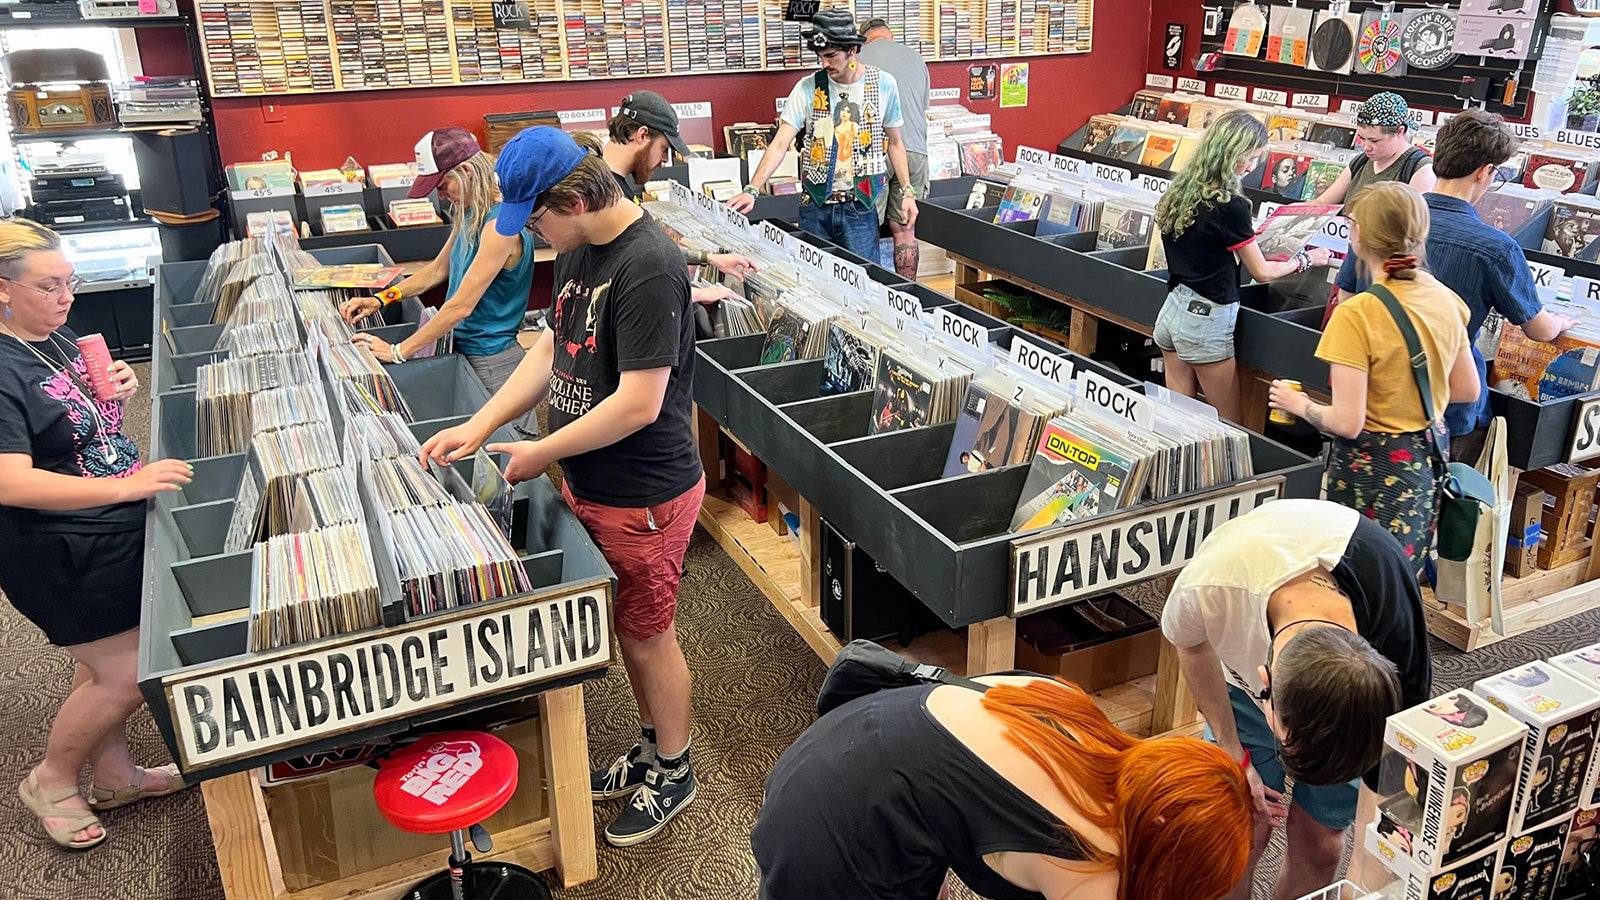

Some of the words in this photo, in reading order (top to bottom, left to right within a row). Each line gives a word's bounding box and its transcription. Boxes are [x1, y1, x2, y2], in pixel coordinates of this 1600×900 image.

[495, 4, 523, 18] ROCK
[790, 3, 816, 14] ROCK
[1404, 13, 1434, 38] ROCKIN'
[1435, 15, 1456, 37] RUBY'S
[1404, 48, 1451, 66] RECORDS
[1180, 80, 1200, 90] JAZZ
[1219, 86, 1240, 96] JAZZ
[1257, 91, 1279, 101] JAZZ
[1297, 95, 1320, 105] JAZZ
[1409, 111, 1423, 122] &B
[1512, 125, 1539, 138] UES
[1557, 131, 1600, 149] BLUES
[1020, 149, 1043, 165] ROCK
[1054, 157, 1079, 173] ROCK
[1338, 154, 1344, 162] G
[1096, 167, 1124, 183] ROCK
[253, 189, 272, 197] 45'S
[324, 185, 343, 193] 45'S
[672, 182, 687, 199] ROCK
[1143, 177, 1170, 193] ROC
[697, 193, 714, 212] ROCK
[1081, 190, 1085, 198] E
[727, 208, 745, 231] ROCK
[764, 225, 785, 248] ROCK
[1322, 222, 1348, 239] OC
[799, 244, 823, 270] ROCK
[834, 263, 860, 290] ROCK
[843, 296, 848, 307] U
[888, 291, 919, 320] ROCK
[861, 318, 867, 330] V
[896, 318, 904, 330] W
[942, 315, 979, 349] ROCK
[938, 357, 944, 369] X
[1018, 345, 1063, 382] ROCK
[550, 371, 593, 402] ROLINE
[1014, 386, 1024, 401] Z
[1551, 384, 1581, 395] JACKSO
[549, 388, 592, 416] LACHEK
[1086, 379, 1137, 422] ROCK
[1577, 405, 1600, 451] S
[184, 629, 454, 755] BAINBRIDGE
[463, 595, 602, 687] ISLAND
[400, 762, 425, 782] Torin
[401, 750, 457, 798] BIG
[422, 756, 483, 805] RED
[1431, 758, 1447, 789] AMY
[1422, 784, 1445, 850] WINEHOUSE
[1406, 873, 1422, 900] LAR
